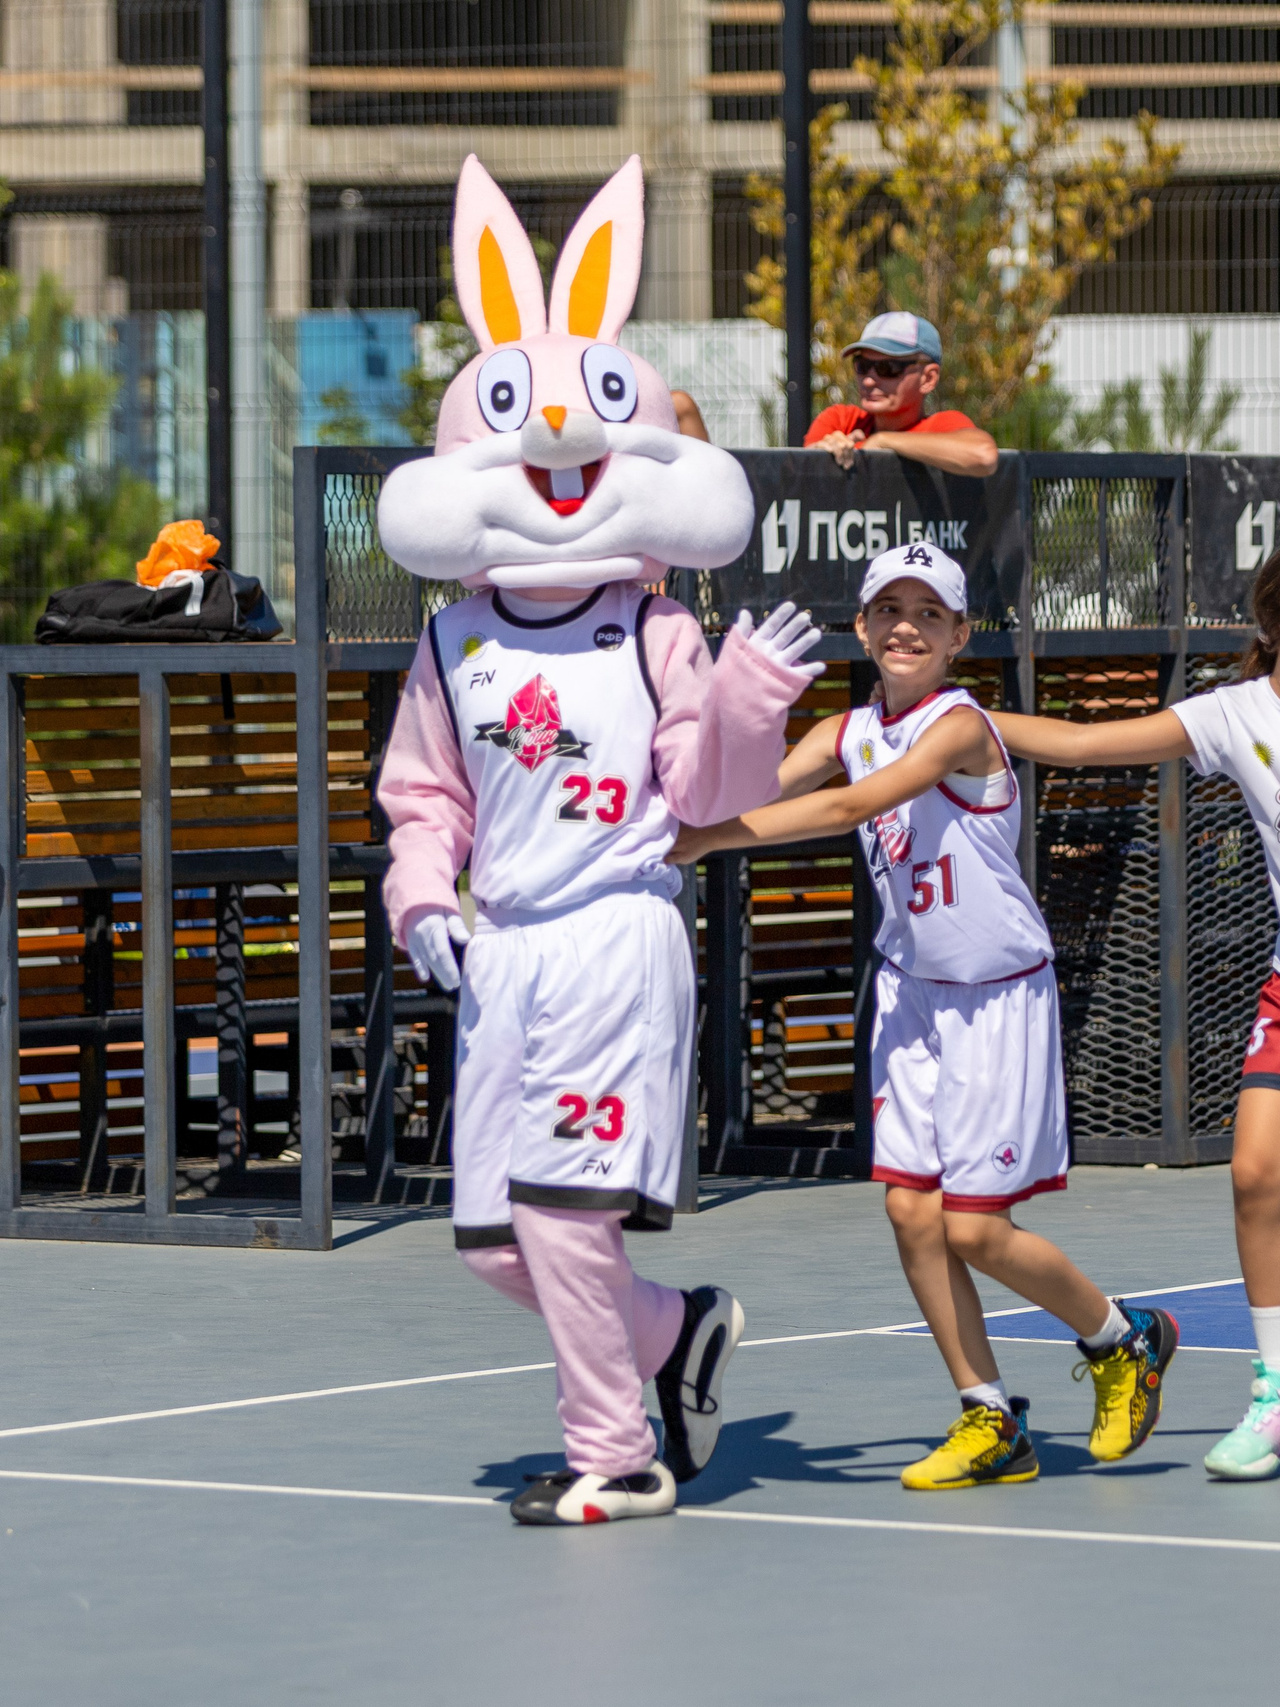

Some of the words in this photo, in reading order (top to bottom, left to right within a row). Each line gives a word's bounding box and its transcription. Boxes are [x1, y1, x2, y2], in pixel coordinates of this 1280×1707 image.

[808, 510, 889, 561] ПСБ
[908, 520, 969, 549] БАНК
[903, 545, 932, 568] LA
[597, 632, 624, 642] РФБ
[470, 669, 496, 689] FN
[556, 771, 630, 827] 23
[907, 853, 959, 917] 51
[552, 1091, 627, 1144] 23
[582, 1159, 613, 1175] FN
